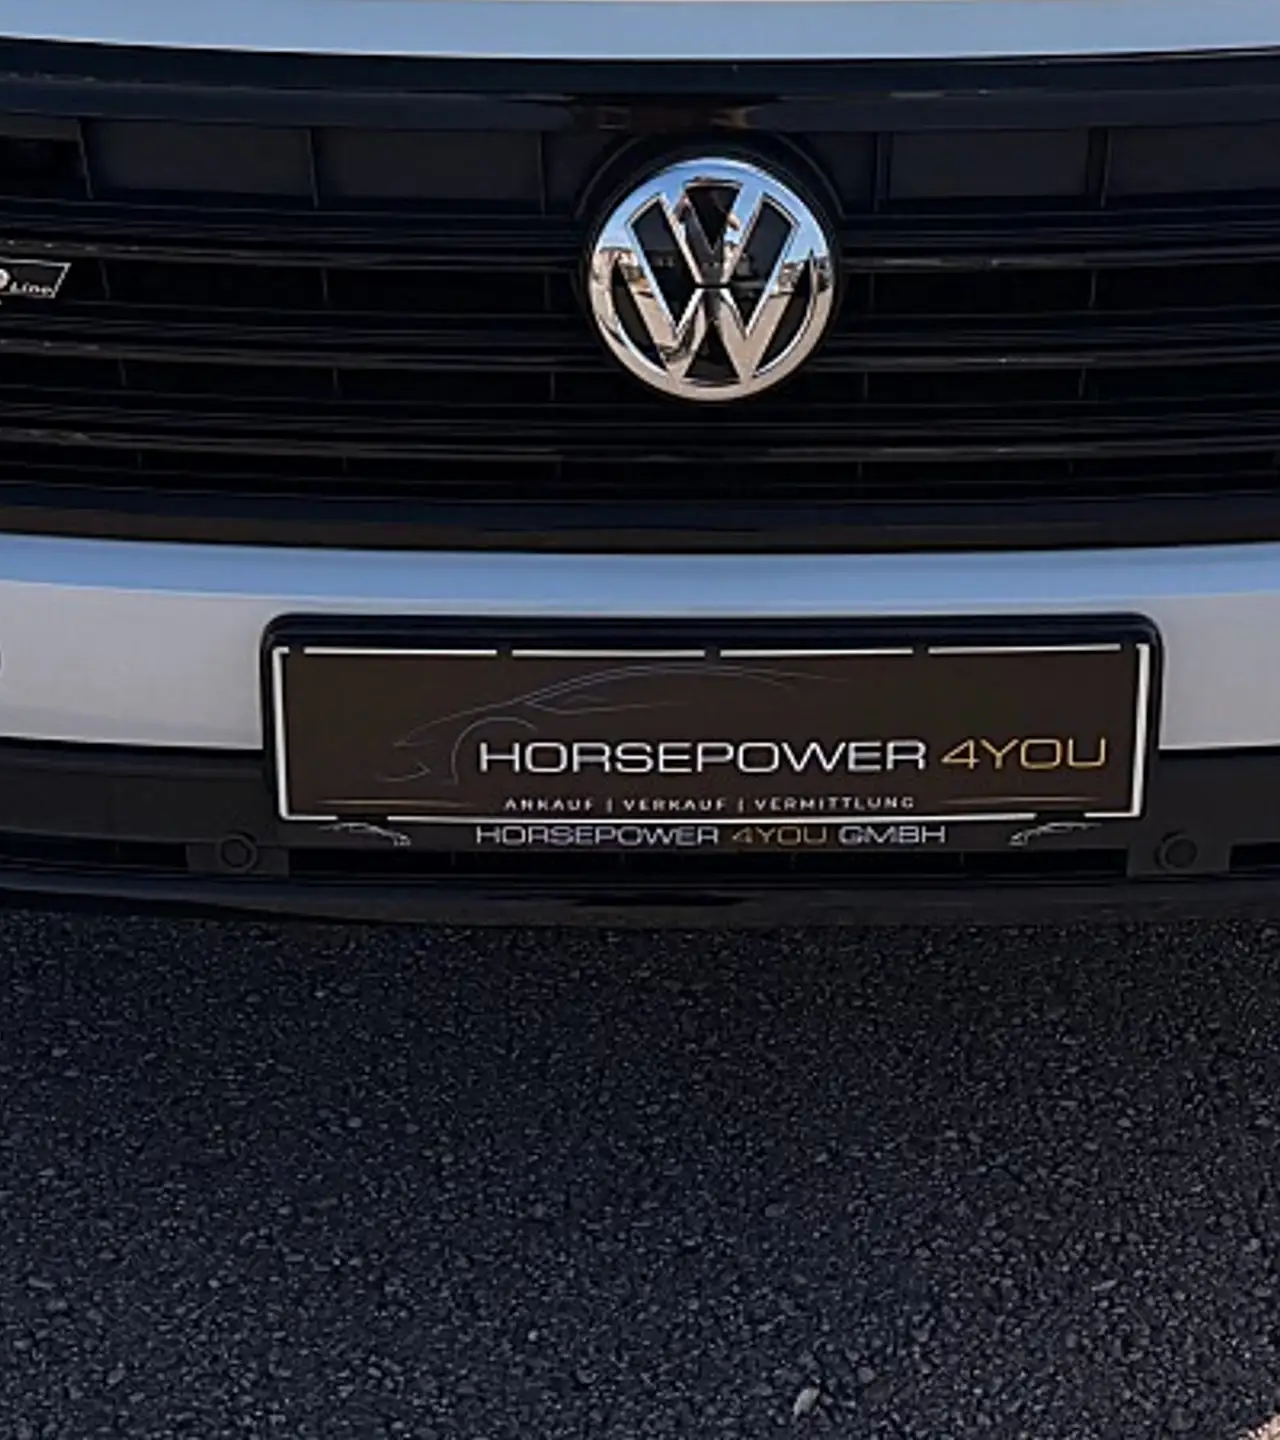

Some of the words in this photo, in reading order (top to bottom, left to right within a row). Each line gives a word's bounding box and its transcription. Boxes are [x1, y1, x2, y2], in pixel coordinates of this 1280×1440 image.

[478, 740, 927, 773] HORSEPOWER
[940, 737, 1107, 770] 4YOU
[505, 797, 595, 812] ANKAUF
[623, 797, 727, 812] VERKAUF
[754, 796, 915, 812] VERMITTLUNG
[475, 825, 720, 846] HORSEPOWER
[731, 825, 827, 845] 4YOU
[837, 824, 947, 846] GMBH
